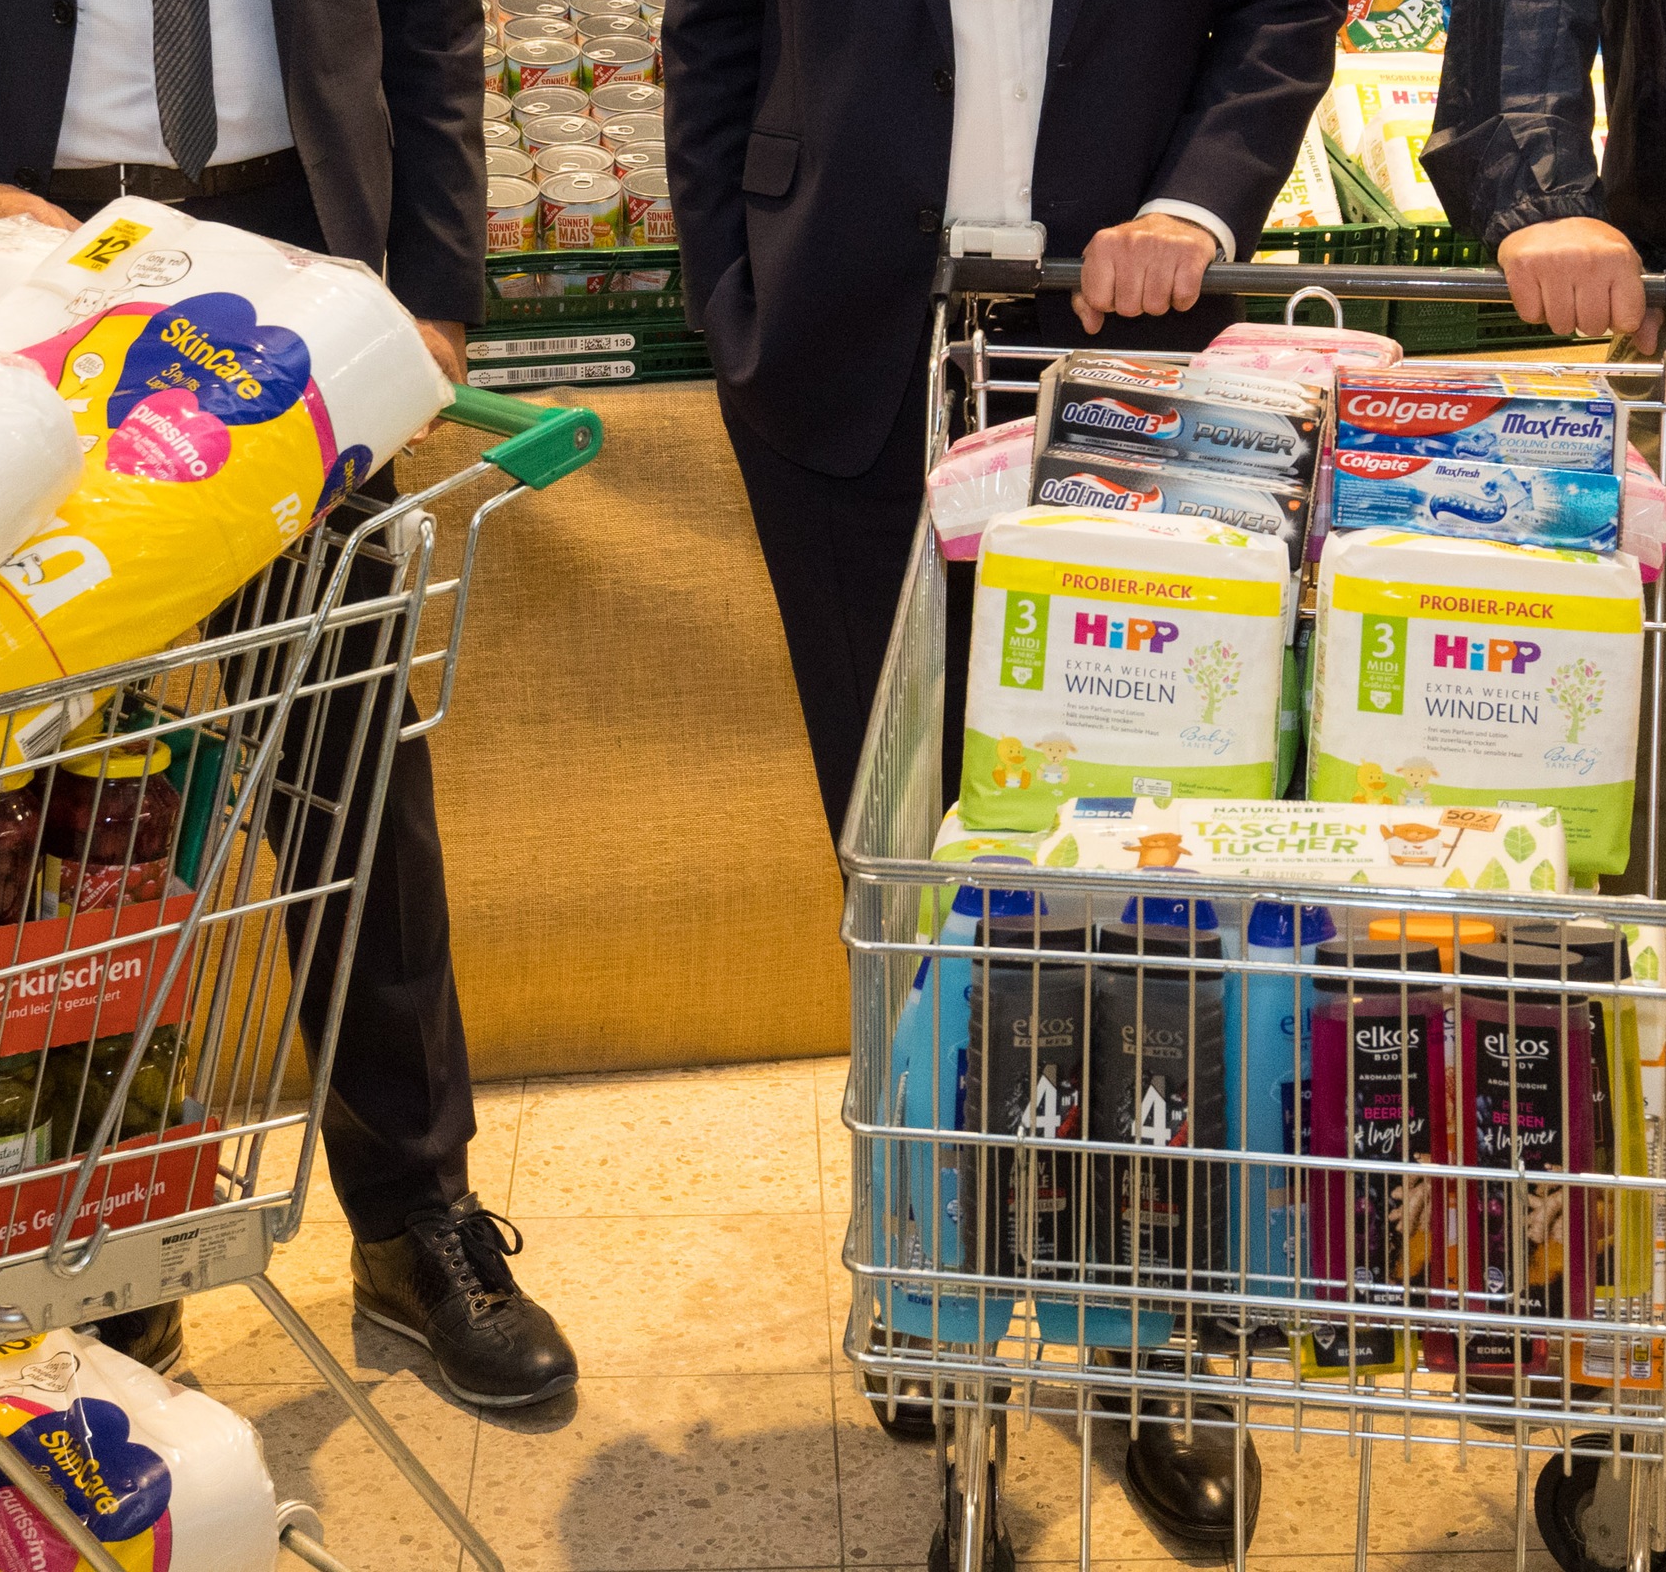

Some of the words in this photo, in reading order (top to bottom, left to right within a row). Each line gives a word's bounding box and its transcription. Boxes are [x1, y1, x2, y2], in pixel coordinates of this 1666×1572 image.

[488, 221, 520, 232] SONNEN
[557, 217, 589, 227] SONNEN
[489, 232, 519, 247] MAIS
[558, 228, 589, 242] MAIS
[84, 236, 131, 264] 12
[614, 338, 632, 347] 136
[160, 317, 262, 400] SkinCare
[614, 366, 631, 374] 136
[1347, 394, 1469, 424] Colgate
[129, 402, 209, 478] purissimo
[1194, 421, 1296, 457] POWER
[1498, 438, 1549, 449] COOLING
[1551, 440, 1603, 452] CRYSTALS
[1340, 453, 1410, 473] Colgate
[1062, 573, 1193, 599] PROBIER-PACK
[1014, 599, 1038, 635] 3
[1420, 594, 1553, 619] PROBIER-PACK
[1009, 636, 1041, 650] MIDI
[1074, 612, 1179, 653] HiPP
[1372, 623, 1395, 658] 3
[1433, 634, 1542, 674] HiPP
[1066, 659, 1113, 673] EXTRA
[1121, 665, 1177, 681] WEICHE
[1367, 661, 1399, 672] MIDI
[1065, 673, 1176, 704] WINDELN
[1426, 683, 1473, 695] EXTRA
[1483, 688, 1540, 701] WEICHE
[1425, 697, 1539, 725] WINDELN
[1179, 726, 1234, 756] Baby
[1543, 746, 1599, 776] Baby
[1191, 821, 1368, 838] TASCHEN
[1204, 837, 1359, 856] TÜCHER
[6, 1006, 28, 1019] und
[161, 1228, 200, 1246] wanzl
[1477, 1346, 1511, 1355] EDEKA
